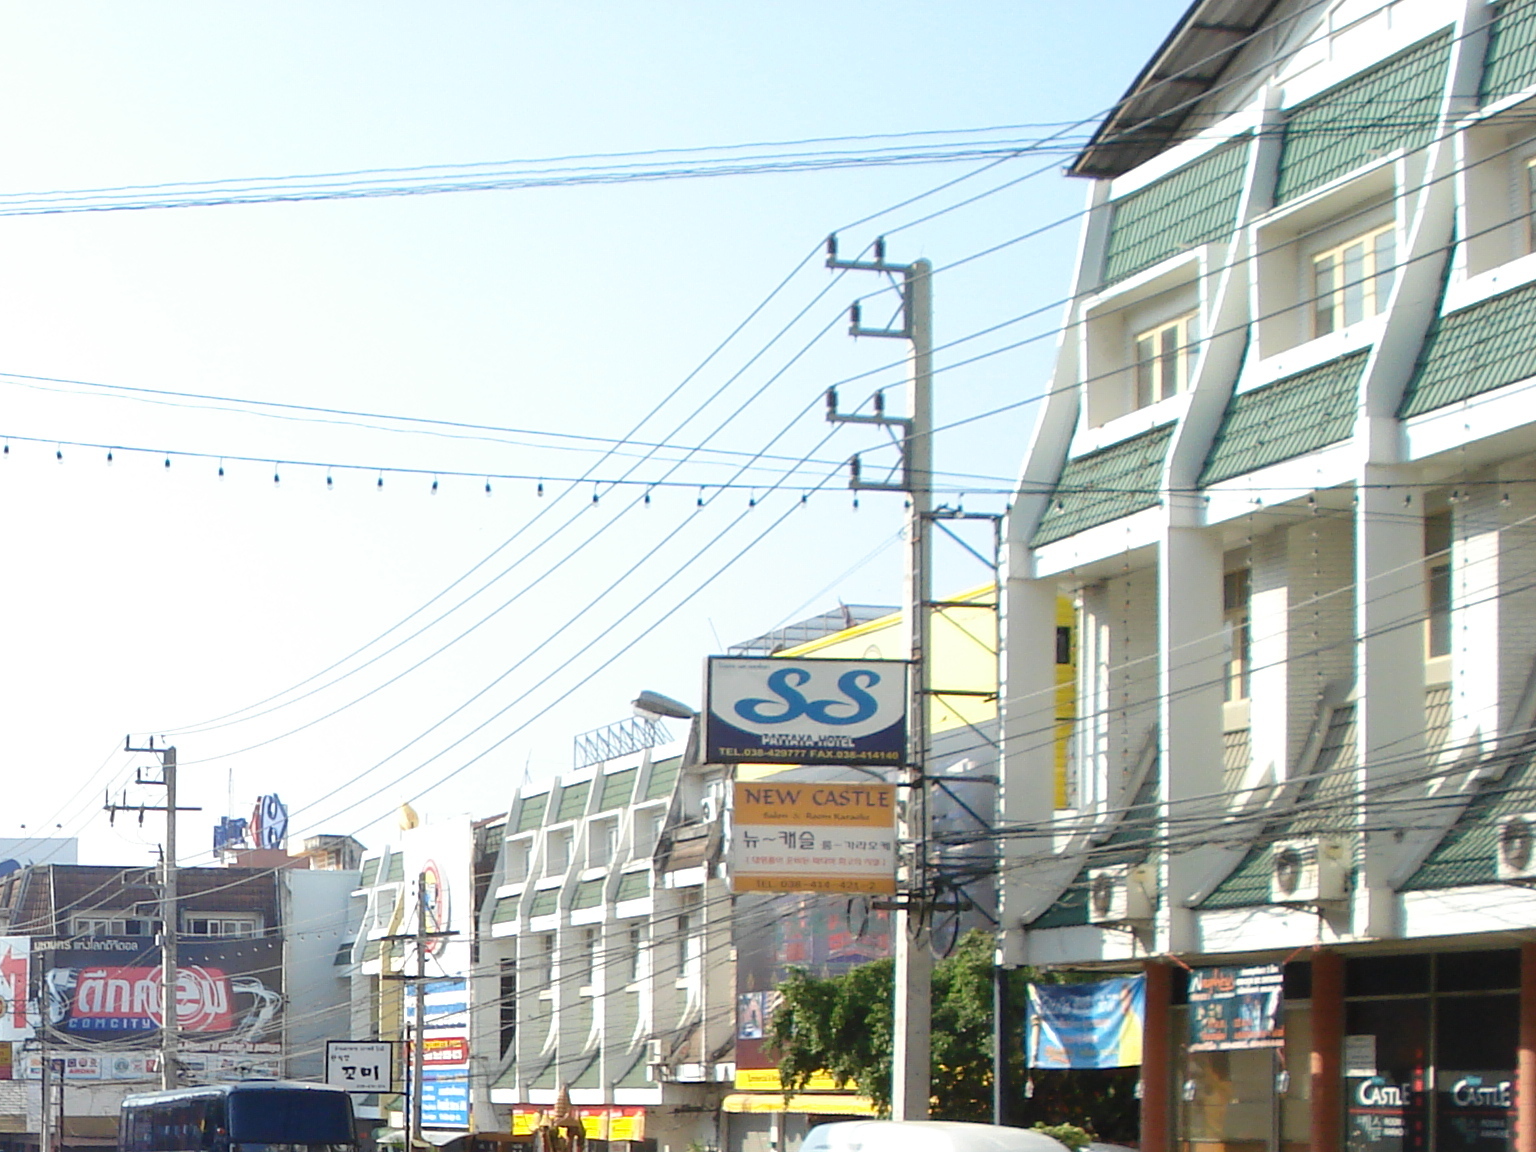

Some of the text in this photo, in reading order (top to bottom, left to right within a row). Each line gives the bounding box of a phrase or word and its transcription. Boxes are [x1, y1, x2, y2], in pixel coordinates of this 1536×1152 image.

[761, 733, 855, 748] PATTAYA HOTEL
[745, 789, 890, 808] NEW CASTLE
[1356, 1078, 1411, 1106] CASTLE
[1453, 1079, 1512, 1107] CASTLE
